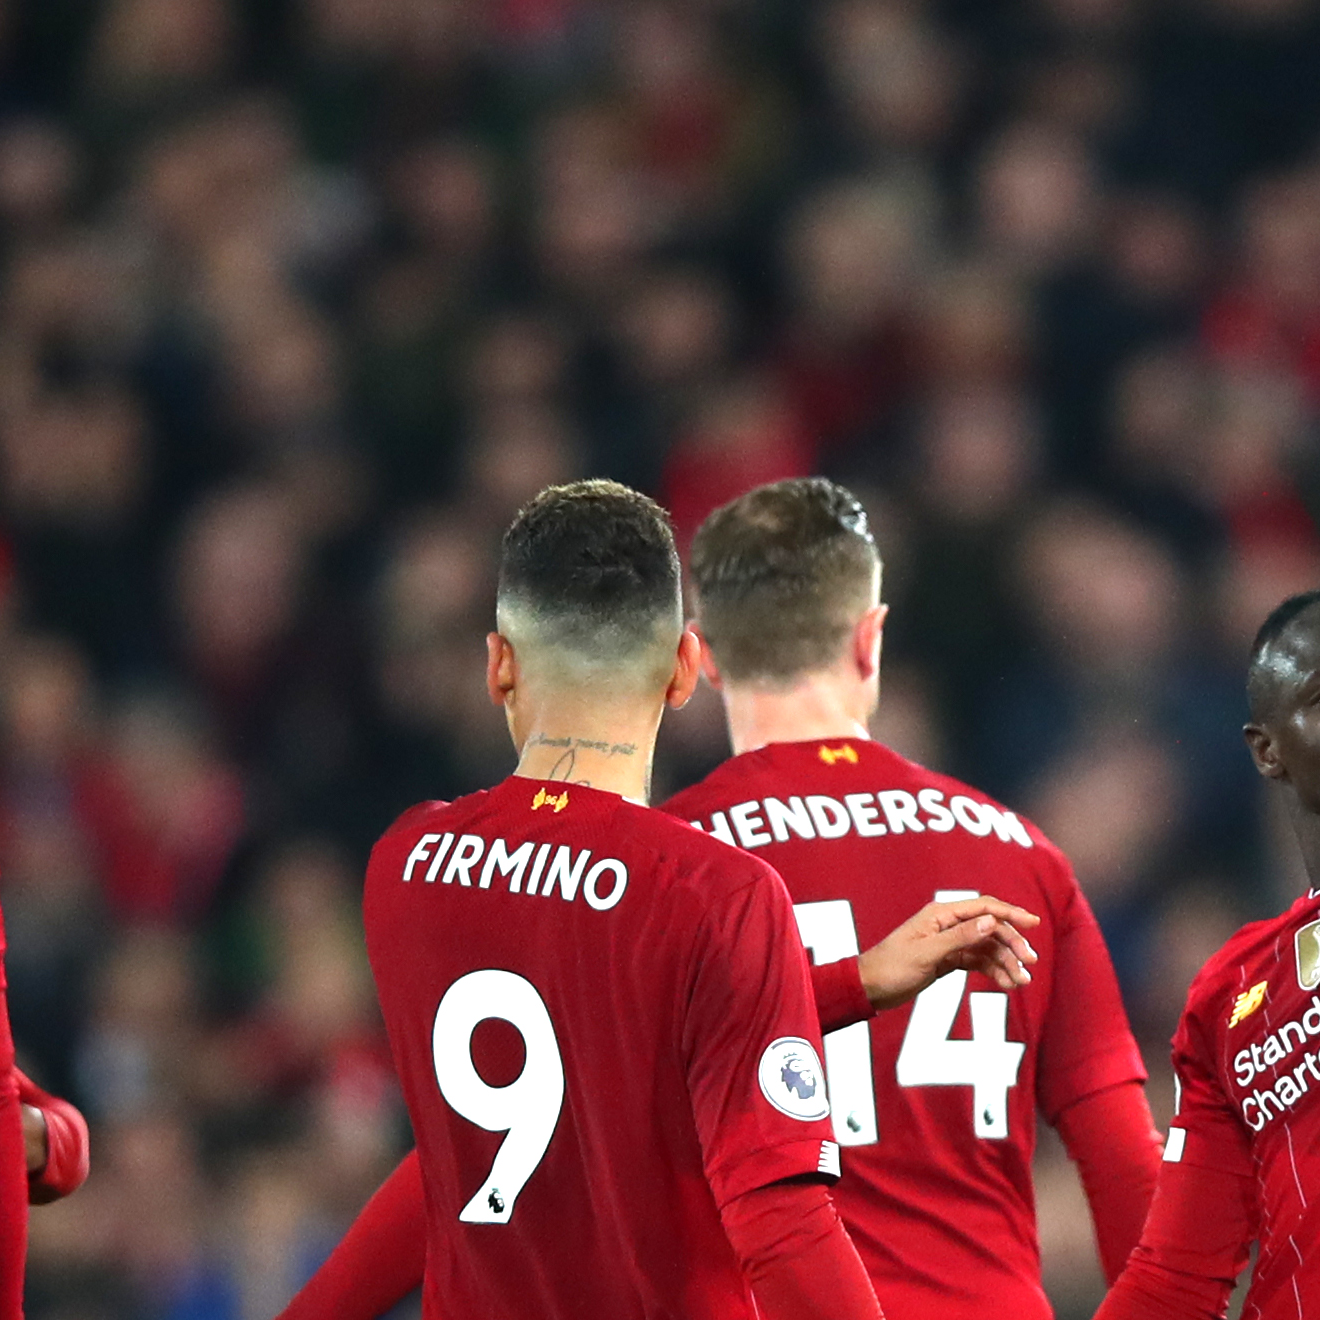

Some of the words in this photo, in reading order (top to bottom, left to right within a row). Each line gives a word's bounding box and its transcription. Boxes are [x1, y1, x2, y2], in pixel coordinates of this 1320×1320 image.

[403, 833, 628, 911] FIRMINO
[691, 788, 1034, 849] HENDERSON
[432, 969, 565, 1224] 9
[793, 890, 1026, 1146] 14
